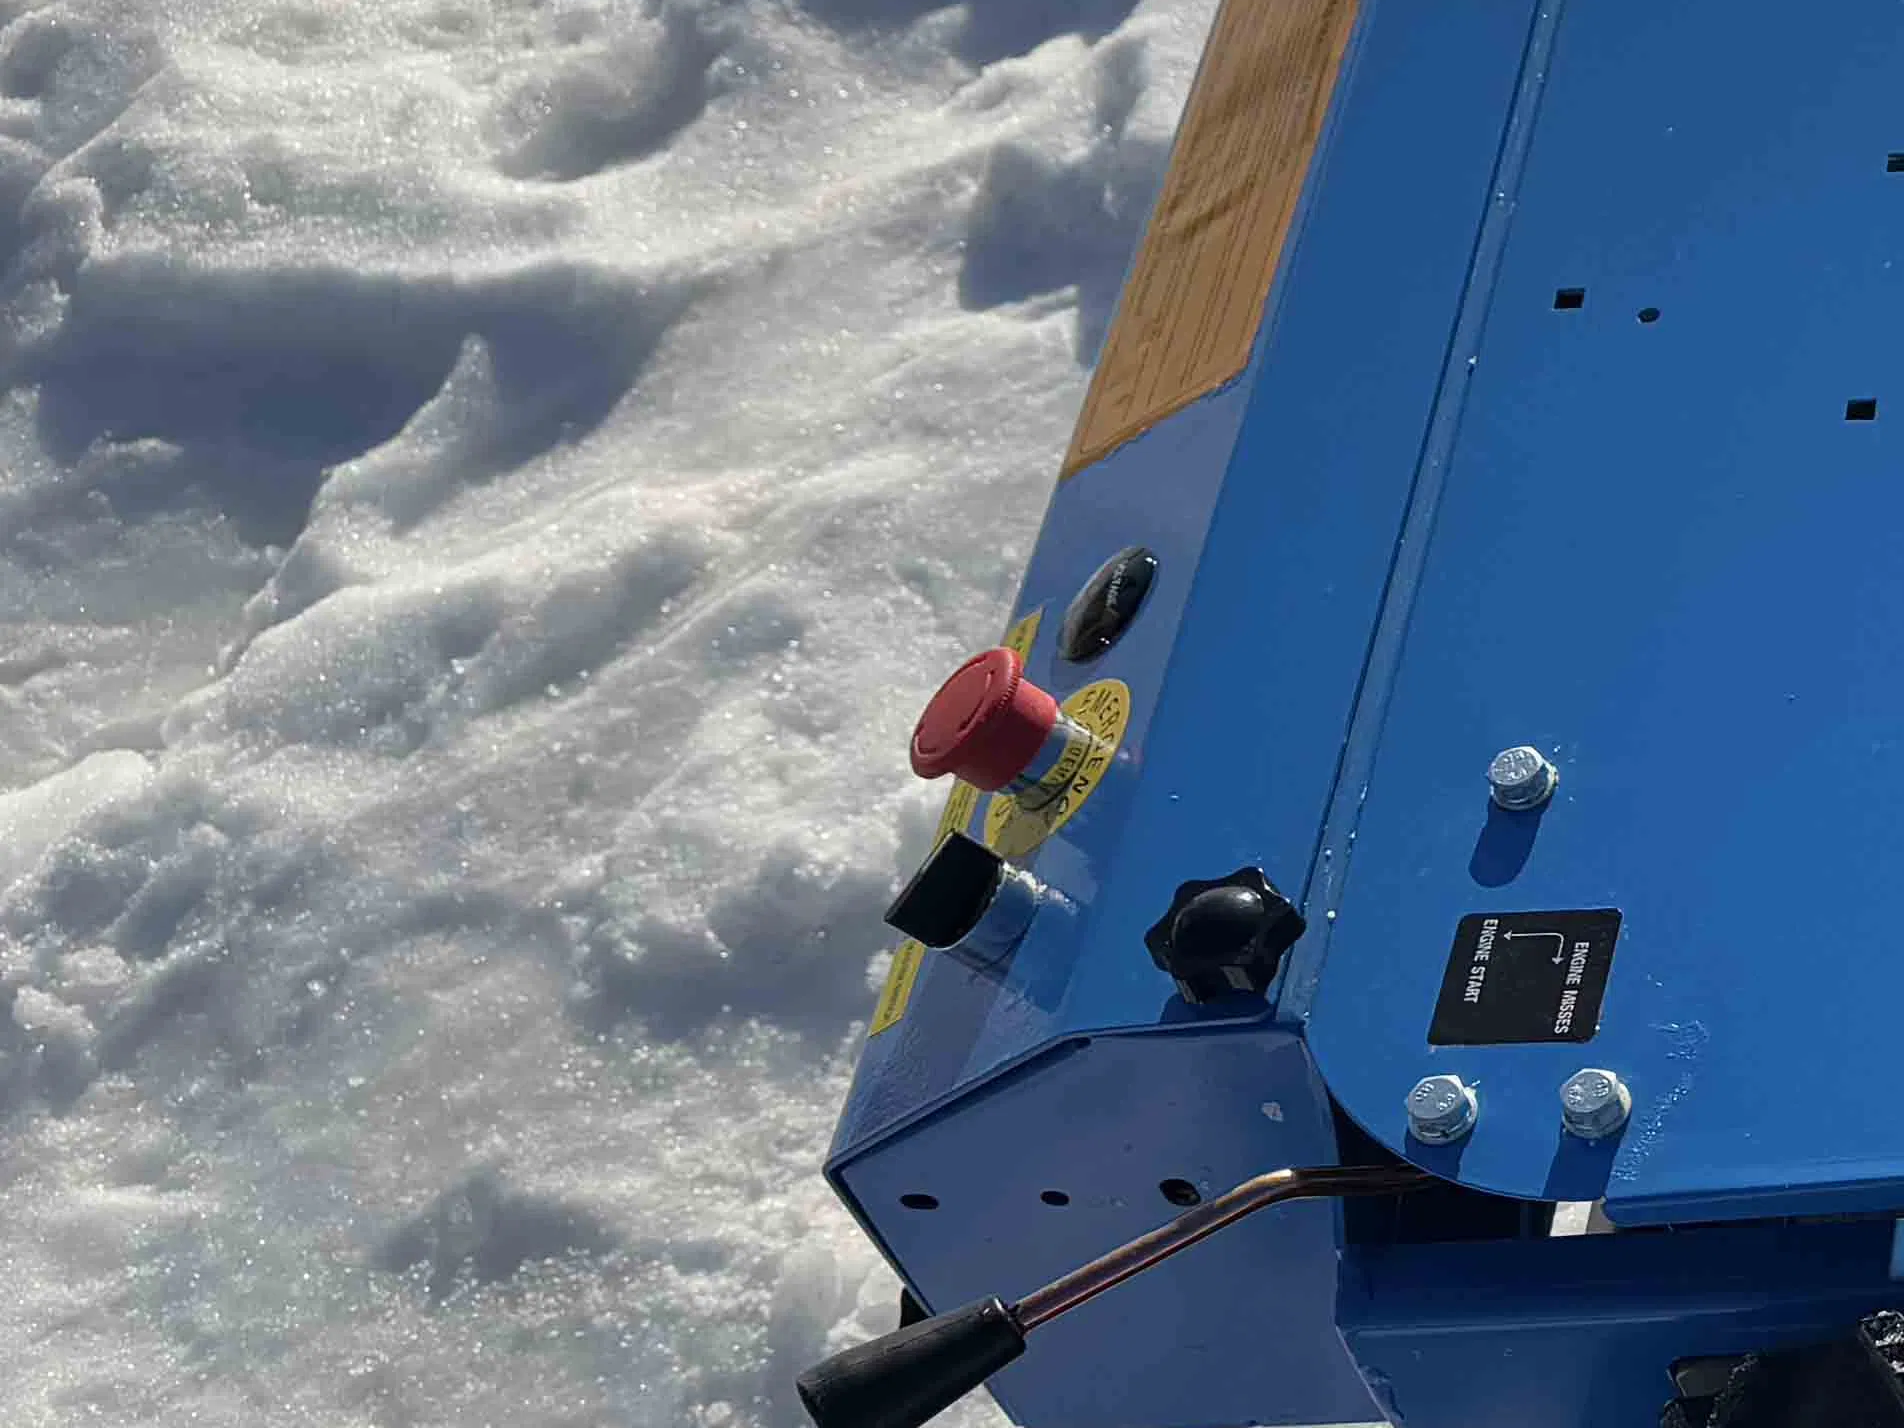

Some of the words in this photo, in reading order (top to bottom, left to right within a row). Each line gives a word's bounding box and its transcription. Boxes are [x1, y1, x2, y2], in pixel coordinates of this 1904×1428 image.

[1474, 918, 1499, 962] ENGINE
[1463, 966, 1486, 1004] START
[1565, 941, 1590, 985] ENGINE
[1554, 990, 1579, 1034] MISSES
